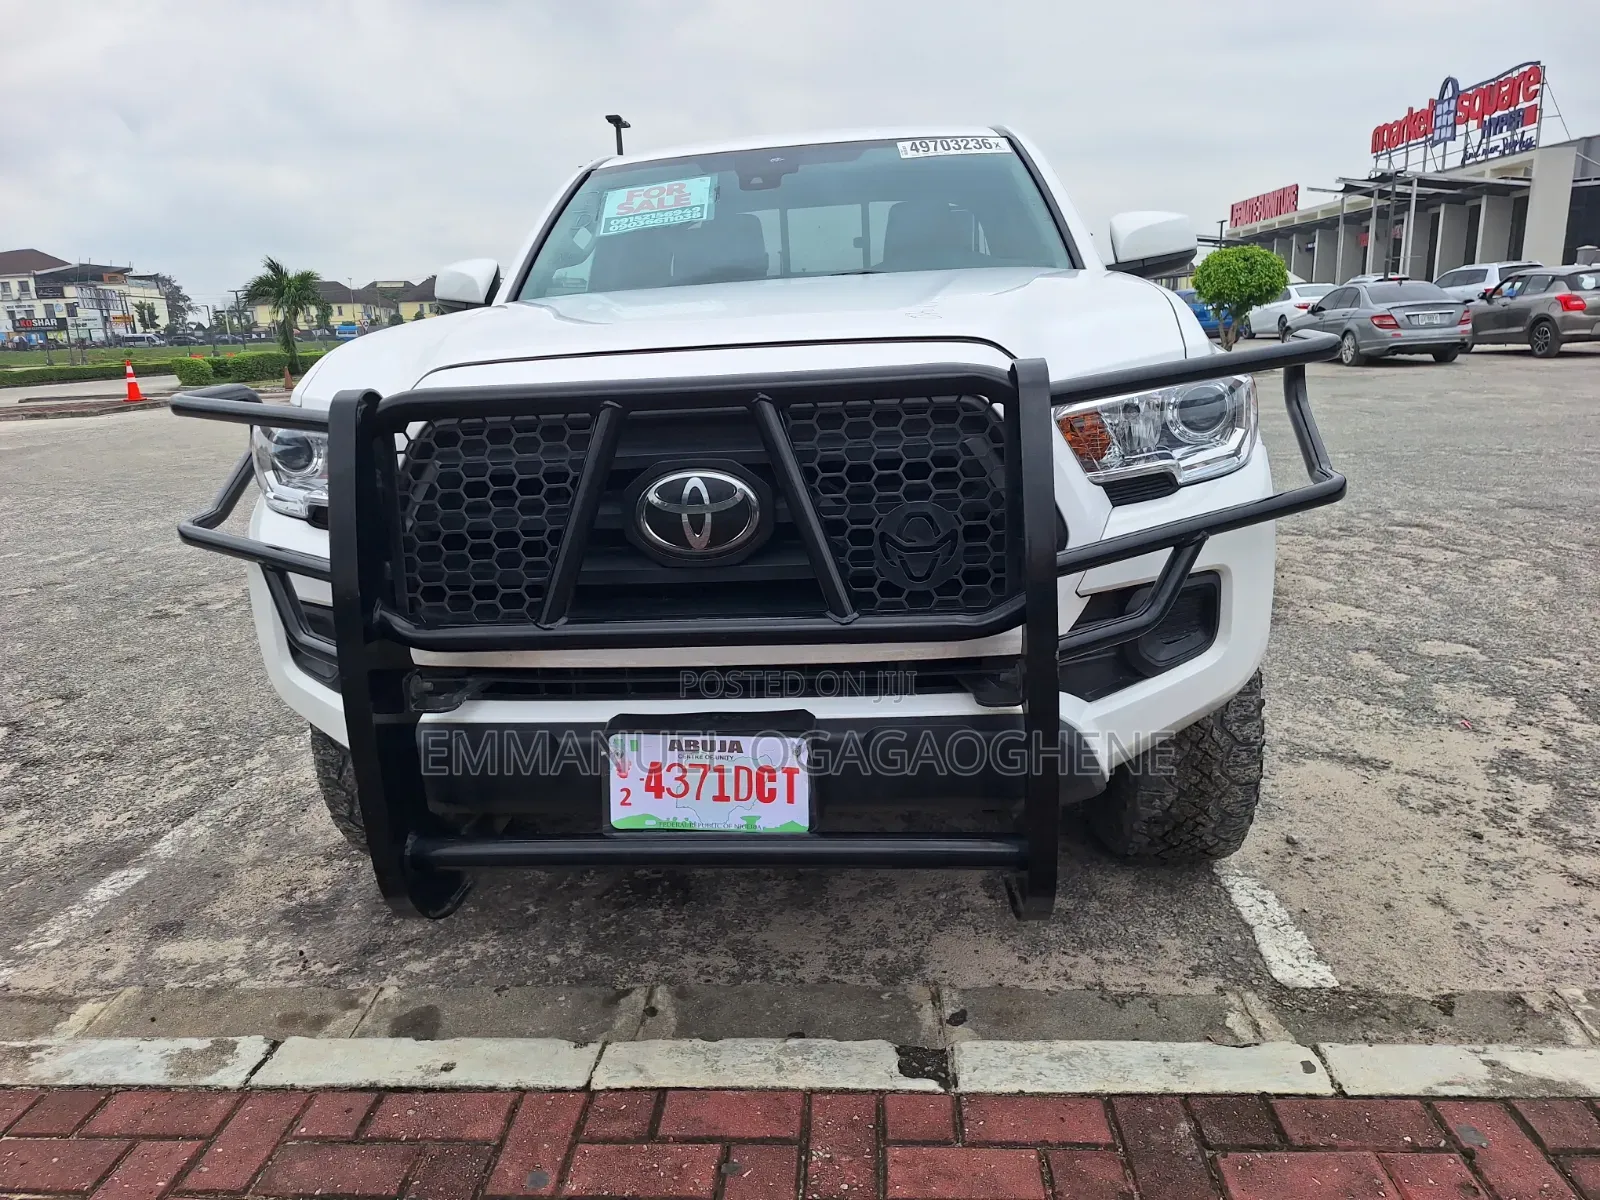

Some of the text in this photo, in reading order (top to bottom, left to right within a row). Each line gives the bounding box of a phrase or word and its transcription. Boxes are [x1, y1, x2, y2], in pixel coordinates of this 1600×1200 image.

[1371, 65, 1541, 154] market square
[1481, 108, 1525, 139] HYPER
[910, 138, 993, 153] 49703236
[625, 183, 687, 203] FOR
[616, 192, 692, 216] SALE
[668, 739, 744, 754] ABUJA
[620, 788, 632, 806] 2
